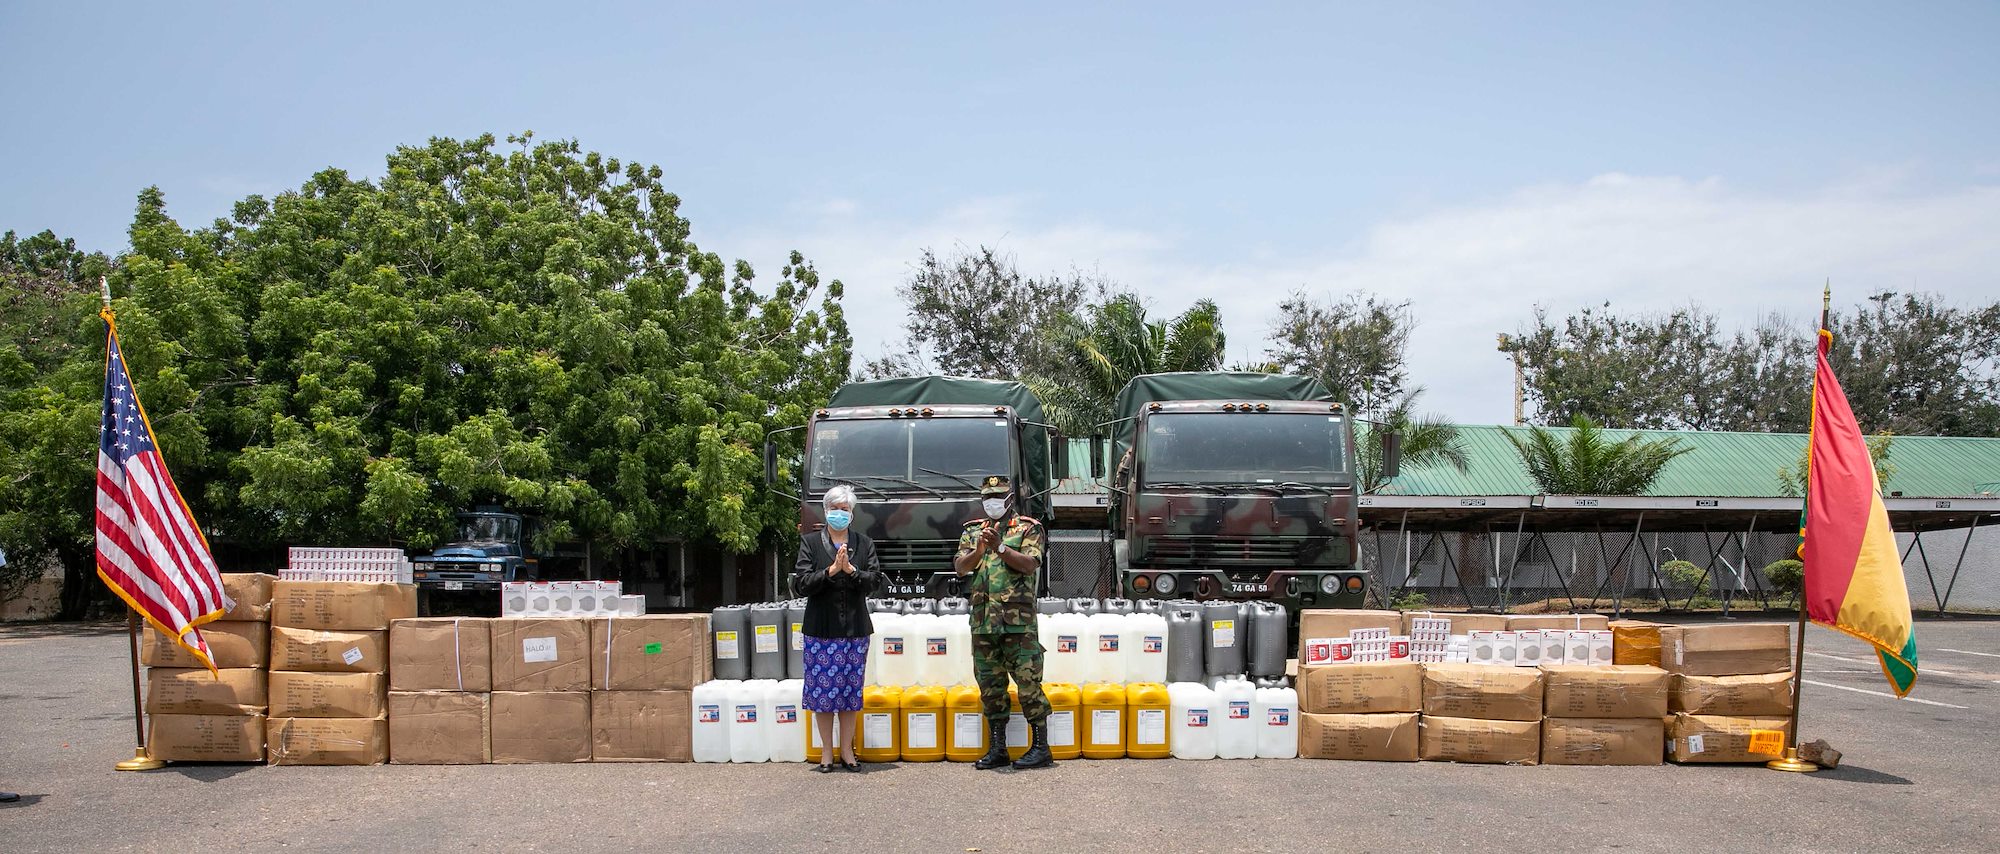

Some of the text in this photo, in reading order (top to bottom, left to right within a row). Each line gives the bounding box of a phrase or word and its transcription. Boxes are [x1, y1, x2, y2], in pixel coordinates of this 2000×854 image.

[887, 585, 925, 594] 74 GA 85
[1232, 584, 1242, 593] 74
[1244, 584, 1256, 593] GA
